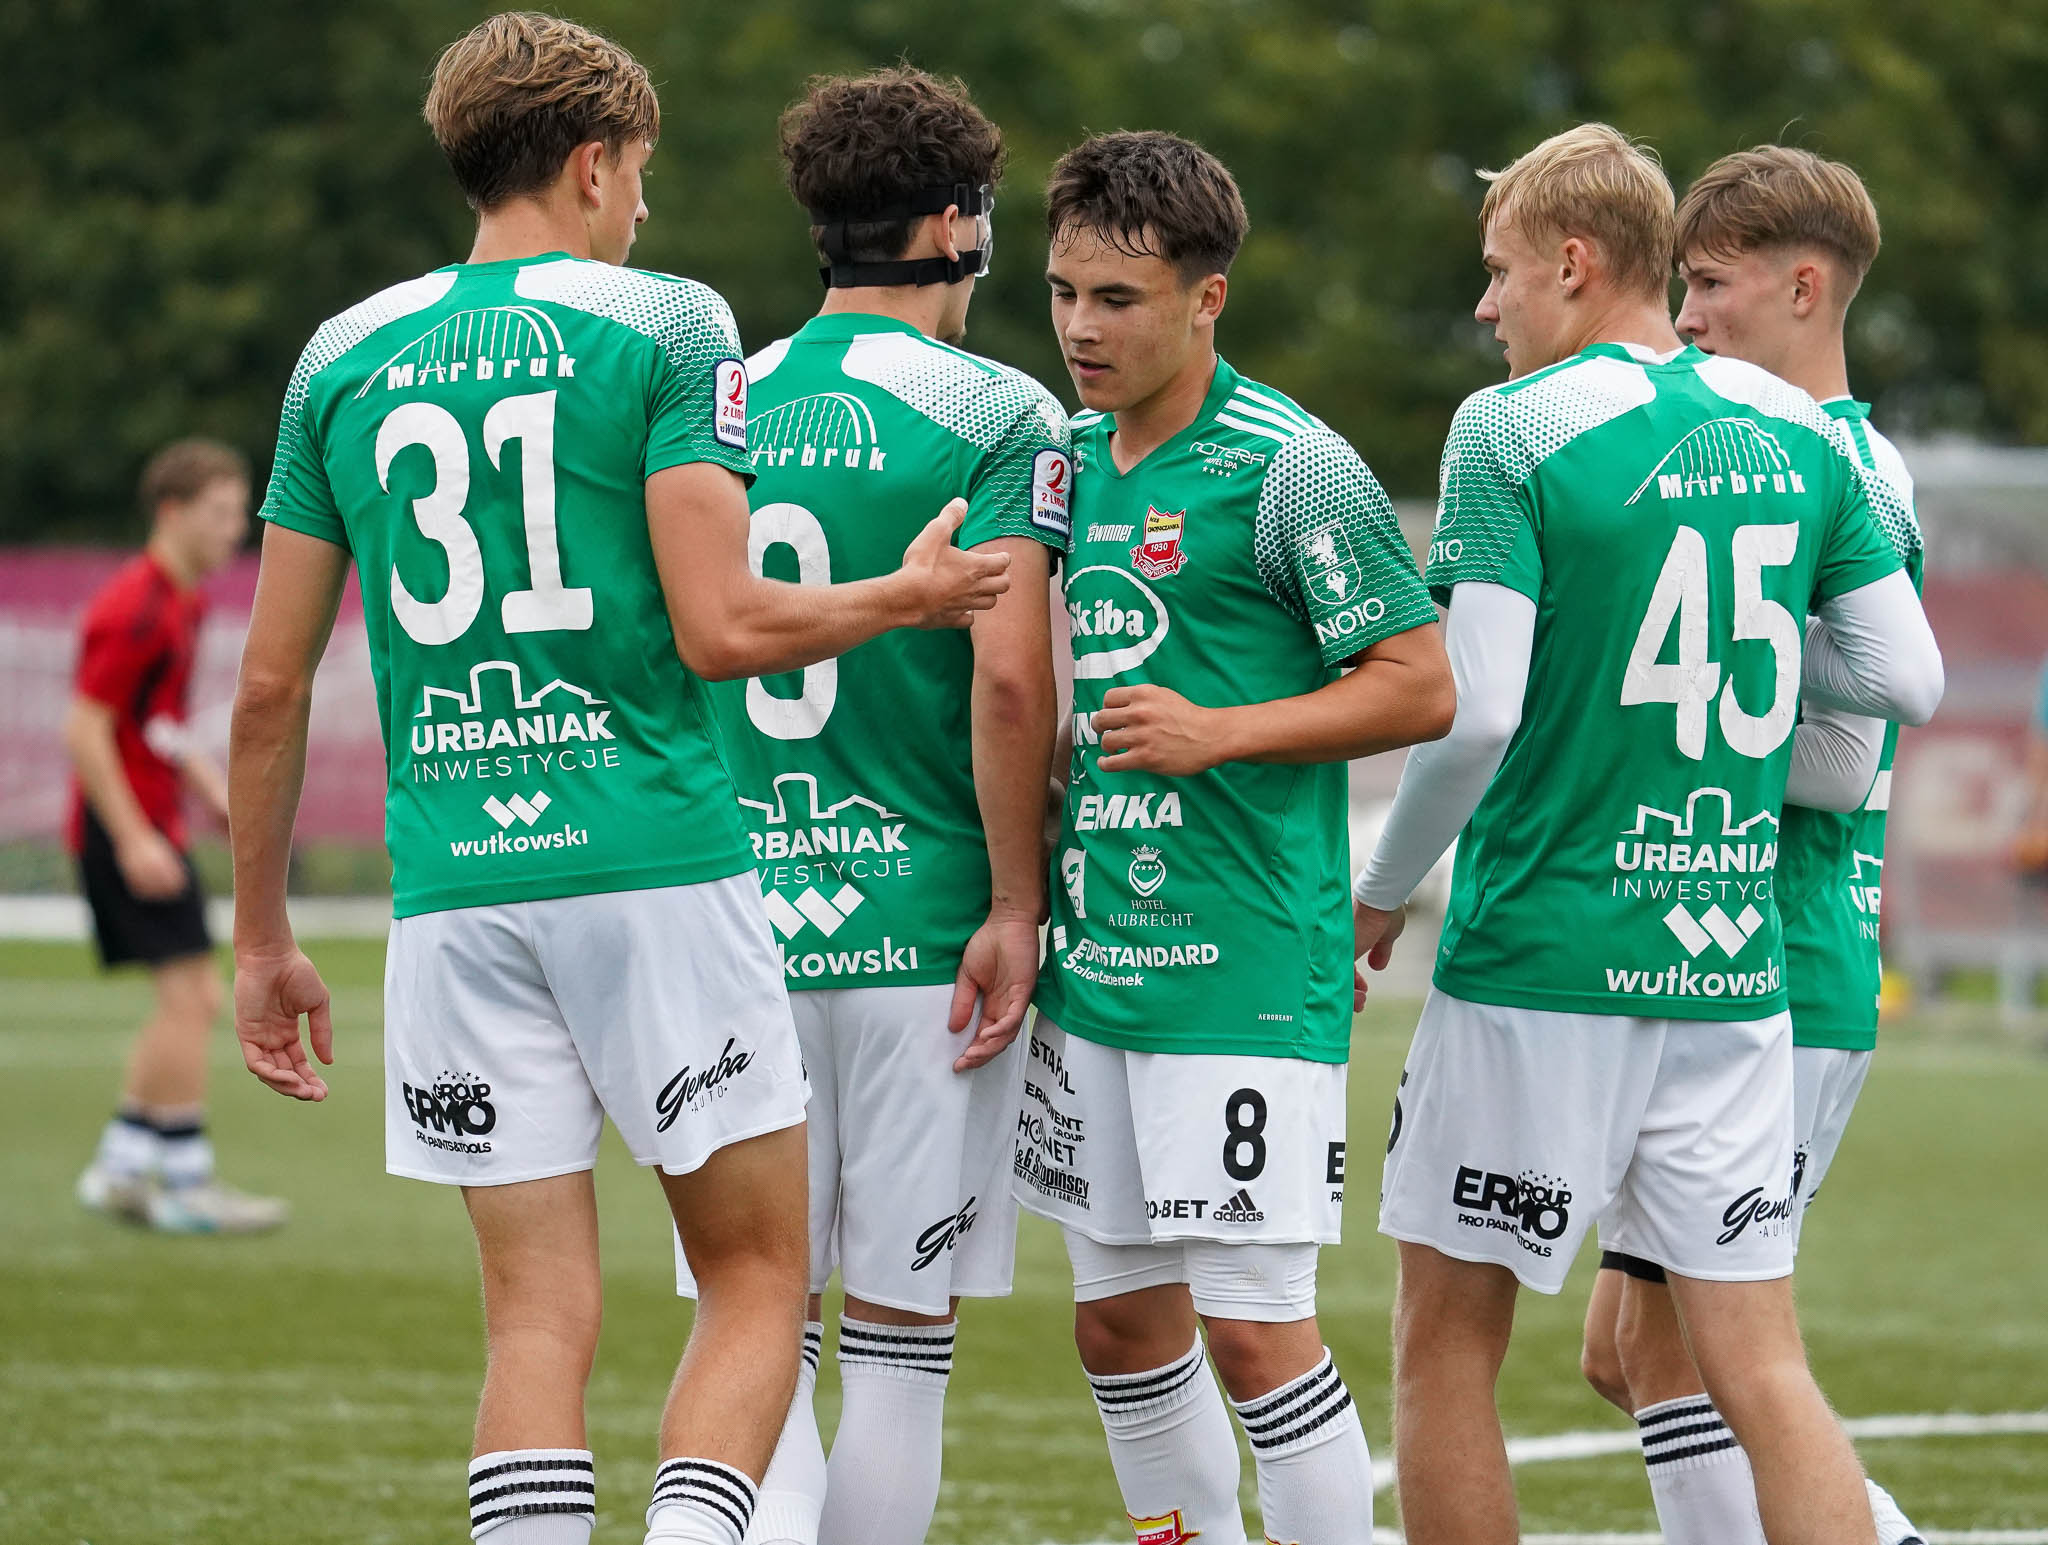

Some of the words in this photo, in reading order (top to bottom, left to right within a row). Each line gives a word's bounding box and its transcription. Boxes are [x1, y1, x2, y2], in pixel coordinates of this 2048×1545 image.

[1223, 460, 1238, 470] SPA
[375, 389, 594, 645] 31
[1151, 543, 1168, 553] 1930
[1620, 520, 1801, 761] 45
[411, 710, 616, 755] URBANIAK
[413, 747, 621, 783] INWESTYCJE
[1075, 792, 1183, 831] EMKA
[451, 824, 588, 857] wutkowski
[749, 824, 909, 859] RBANIAK
[1614, 842, 1778, 873] URBANIA
[1108, 913, 1194, 927] AUBRECHT
[1131, 899, 1166, 910] HOTEL
[1258, 1013, 1293, 1022] AEROREADY
[433, 1083, 490, 1101] GROUP
[656, 1038, 756, 1133] Gemba
[403, 1082, 496, 1136] ERMO
[1053, 1126, 1086, 1142] GROUP
[1223, 1087, 1268, 1182] 8
[1213, 1209, 1264, 1223] adidas
[1457, 1213, 1484, 1227] PRO
